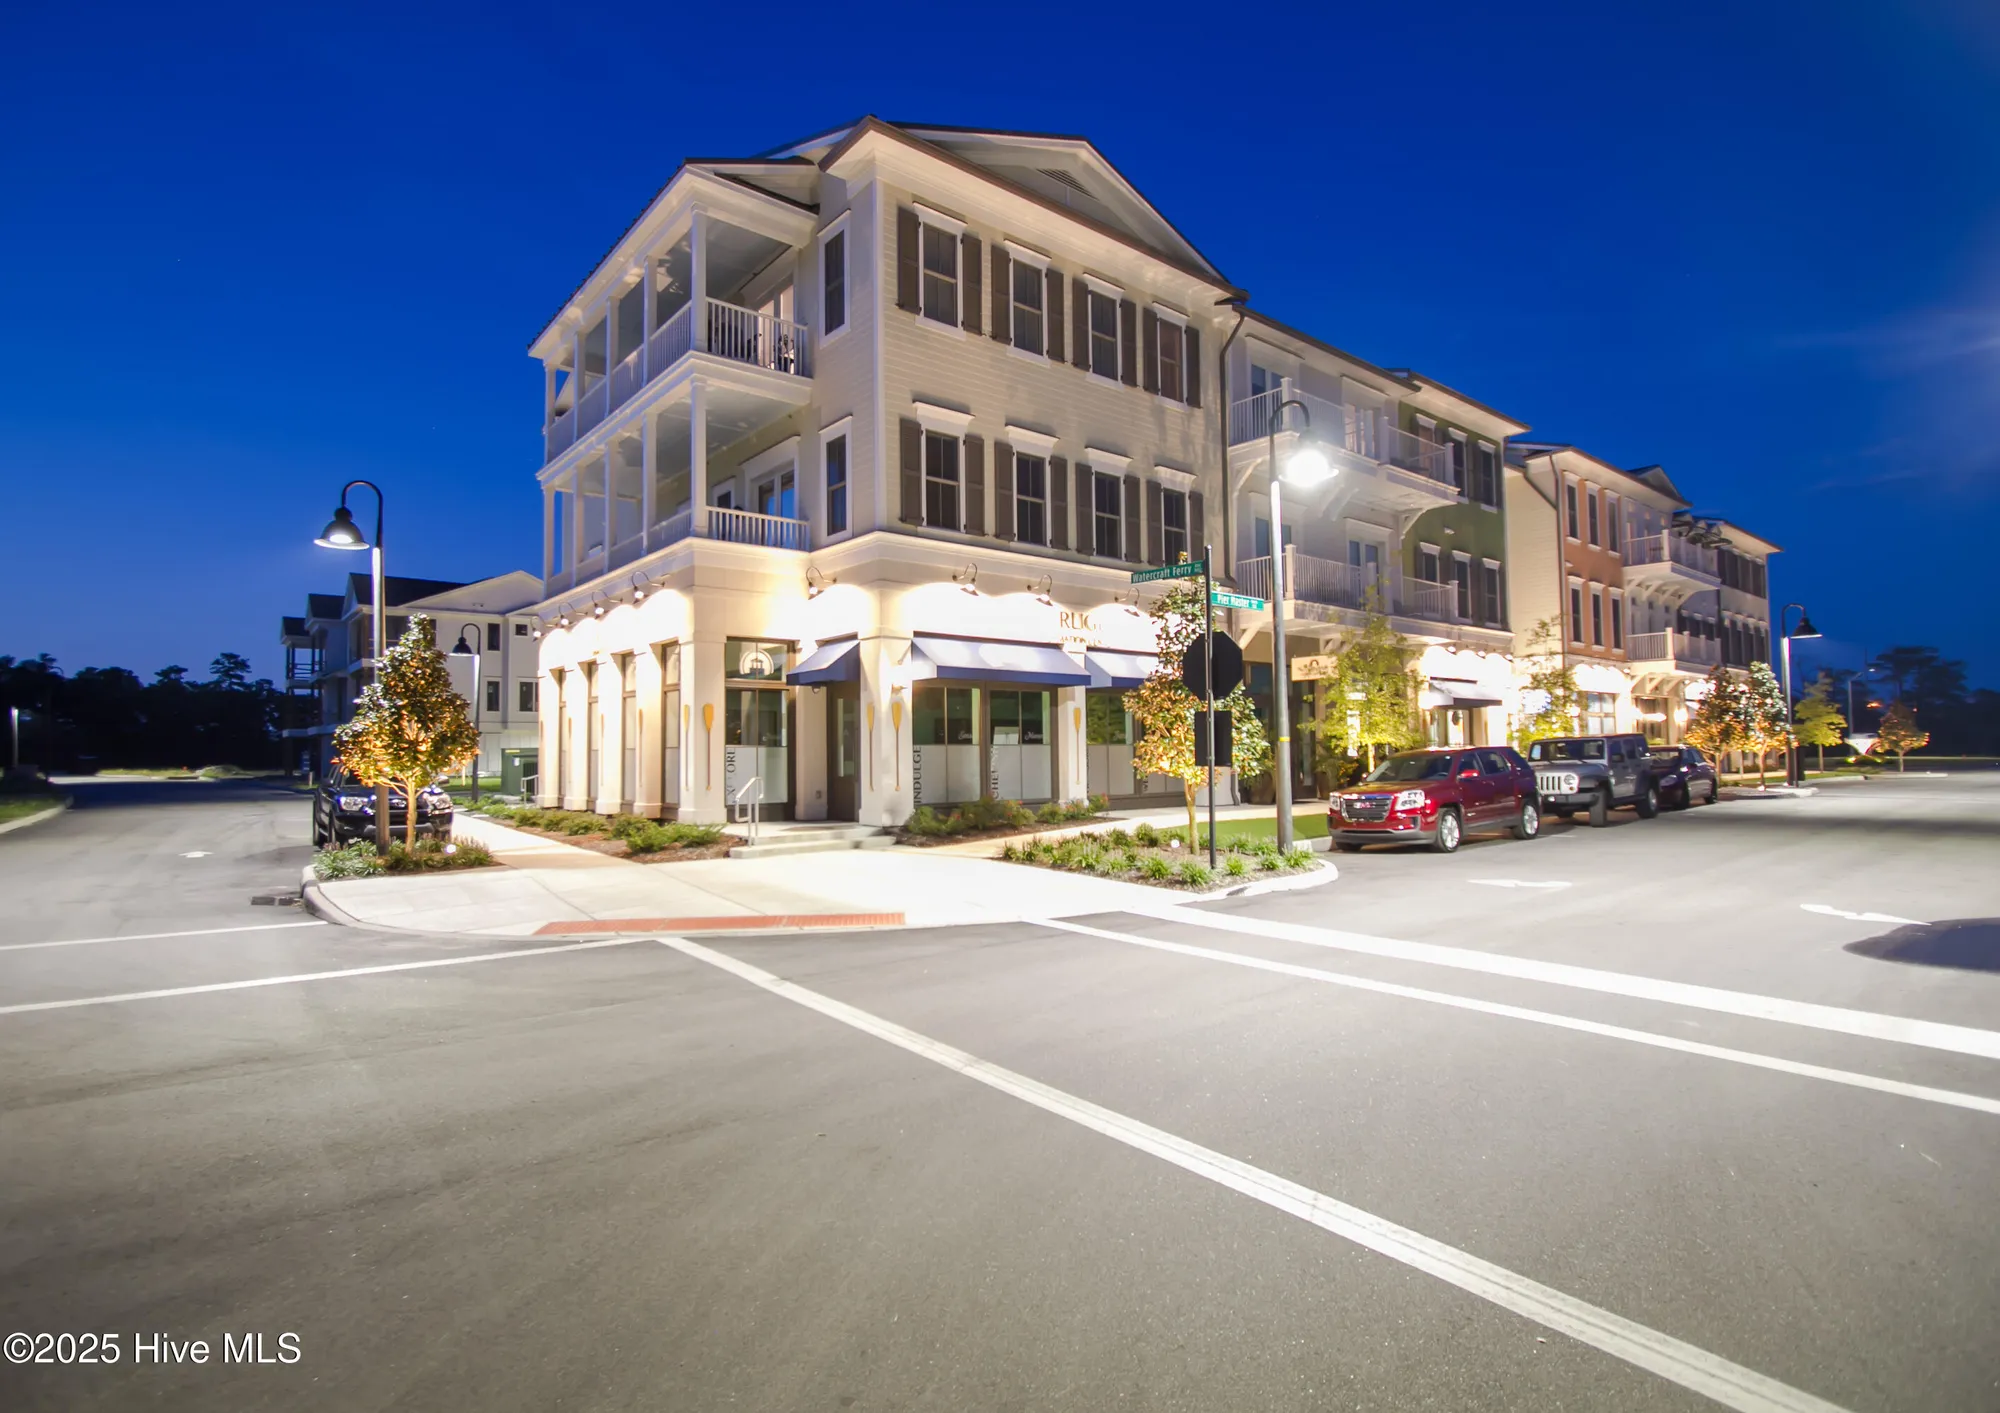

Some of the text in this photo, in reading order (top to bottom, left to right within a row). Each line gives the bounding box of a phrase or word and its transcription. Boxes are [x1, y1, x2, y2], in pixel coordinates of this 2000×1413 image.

[1132, 569, 1170, 583] Watercraft
[1172, 565, 1192, 576] Ferry
[1217, 593, 1229, 604] Pier
[913, 746, 922, 804] INDULGE
